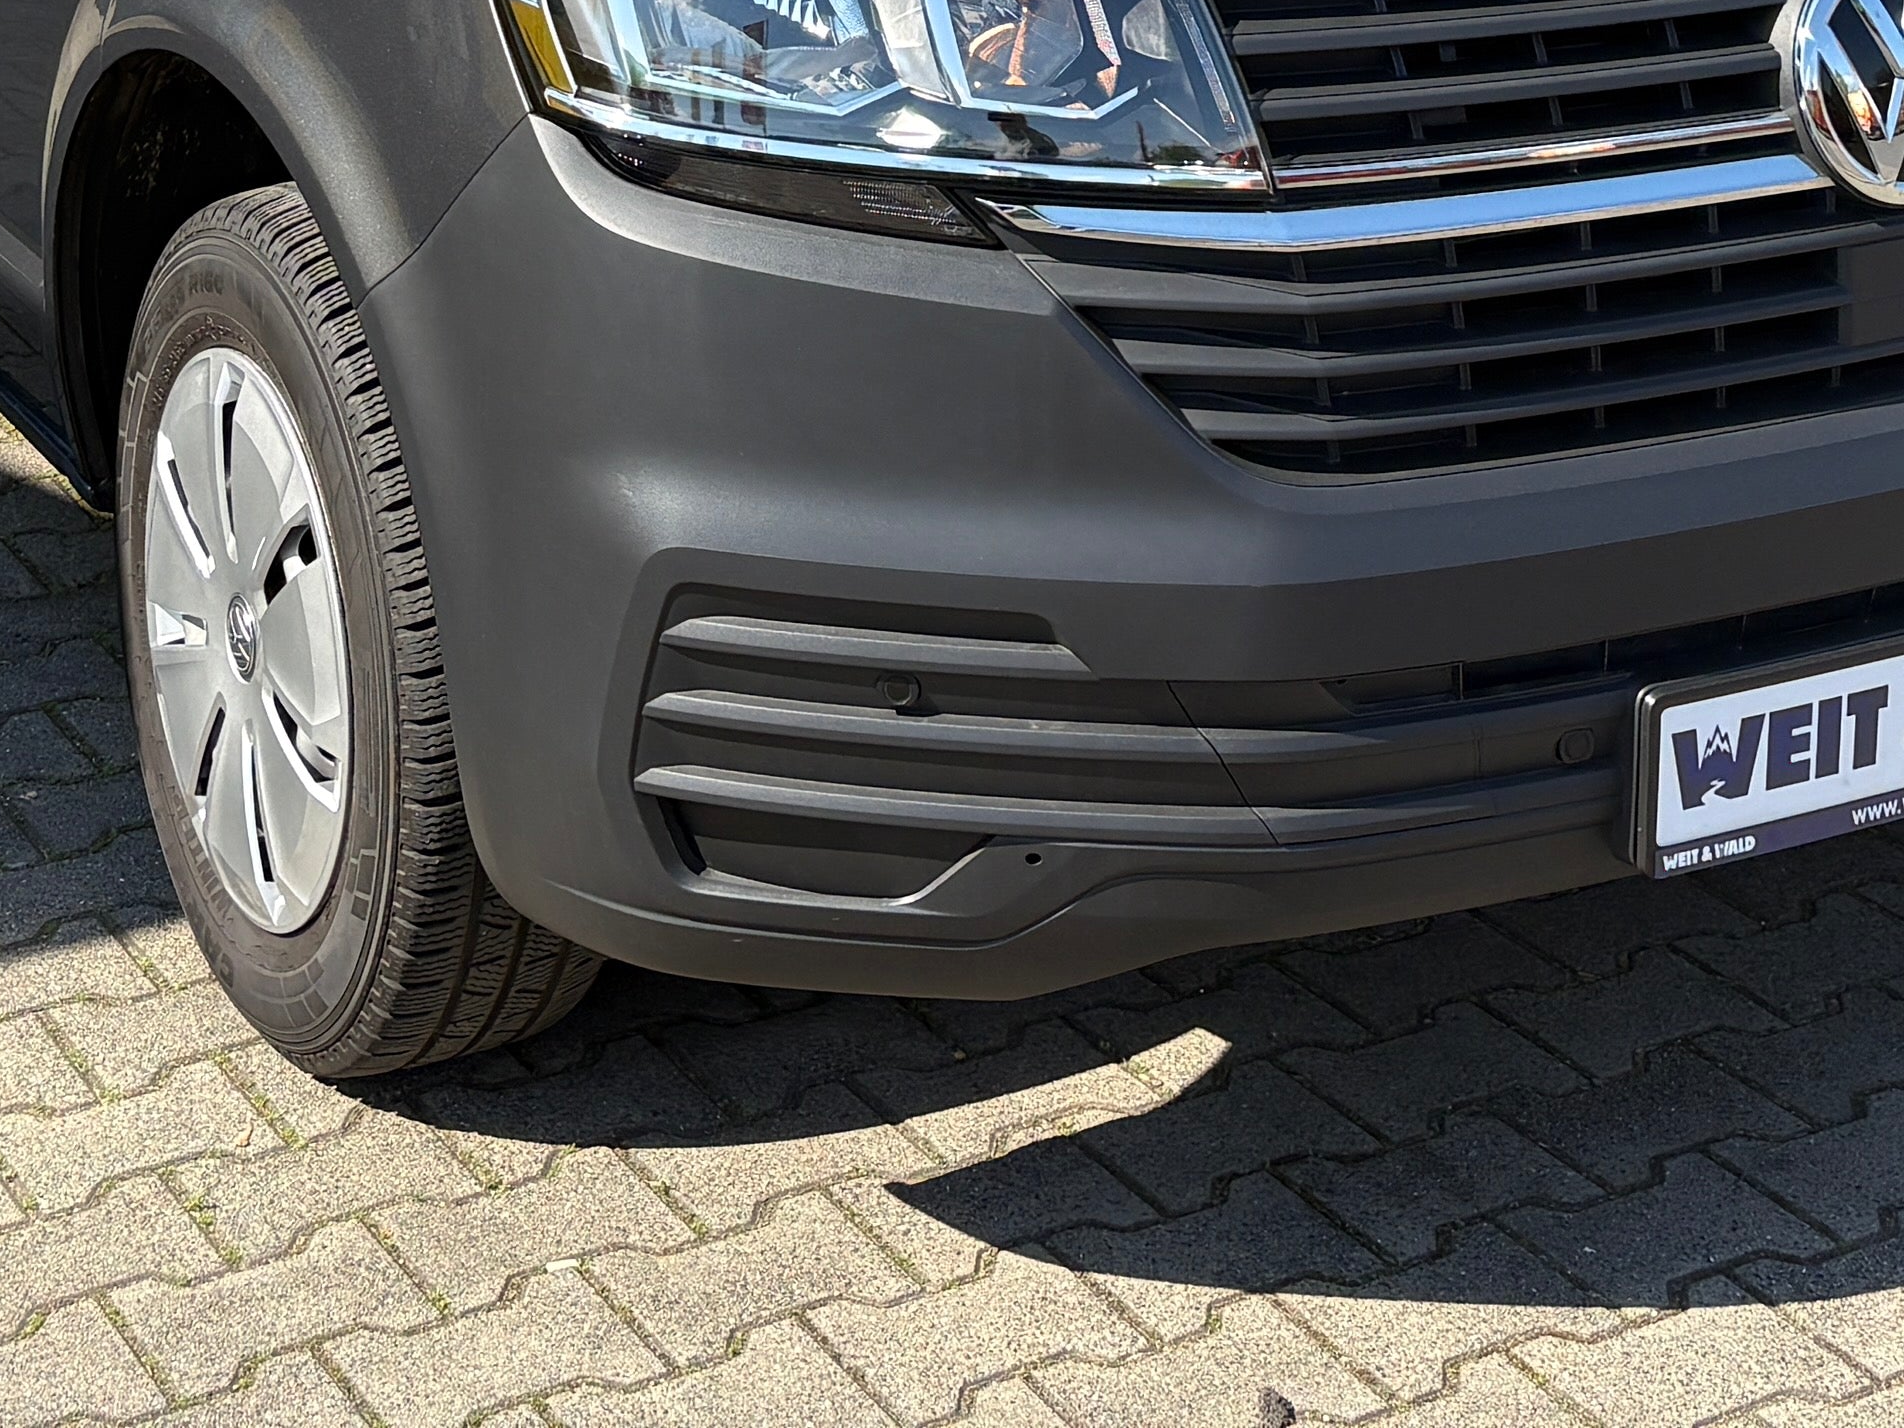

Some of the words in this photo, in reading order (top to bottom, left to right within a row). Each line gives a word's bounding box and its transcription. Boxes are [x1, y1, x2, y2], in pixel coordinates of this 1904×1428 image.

[1671, 684, 1890, 811] WEIT
[1662, 848, 1700, 872] WEIT
[1701, 845, 1713, 862] &
[1714, 835, 1756, 859] WALD
